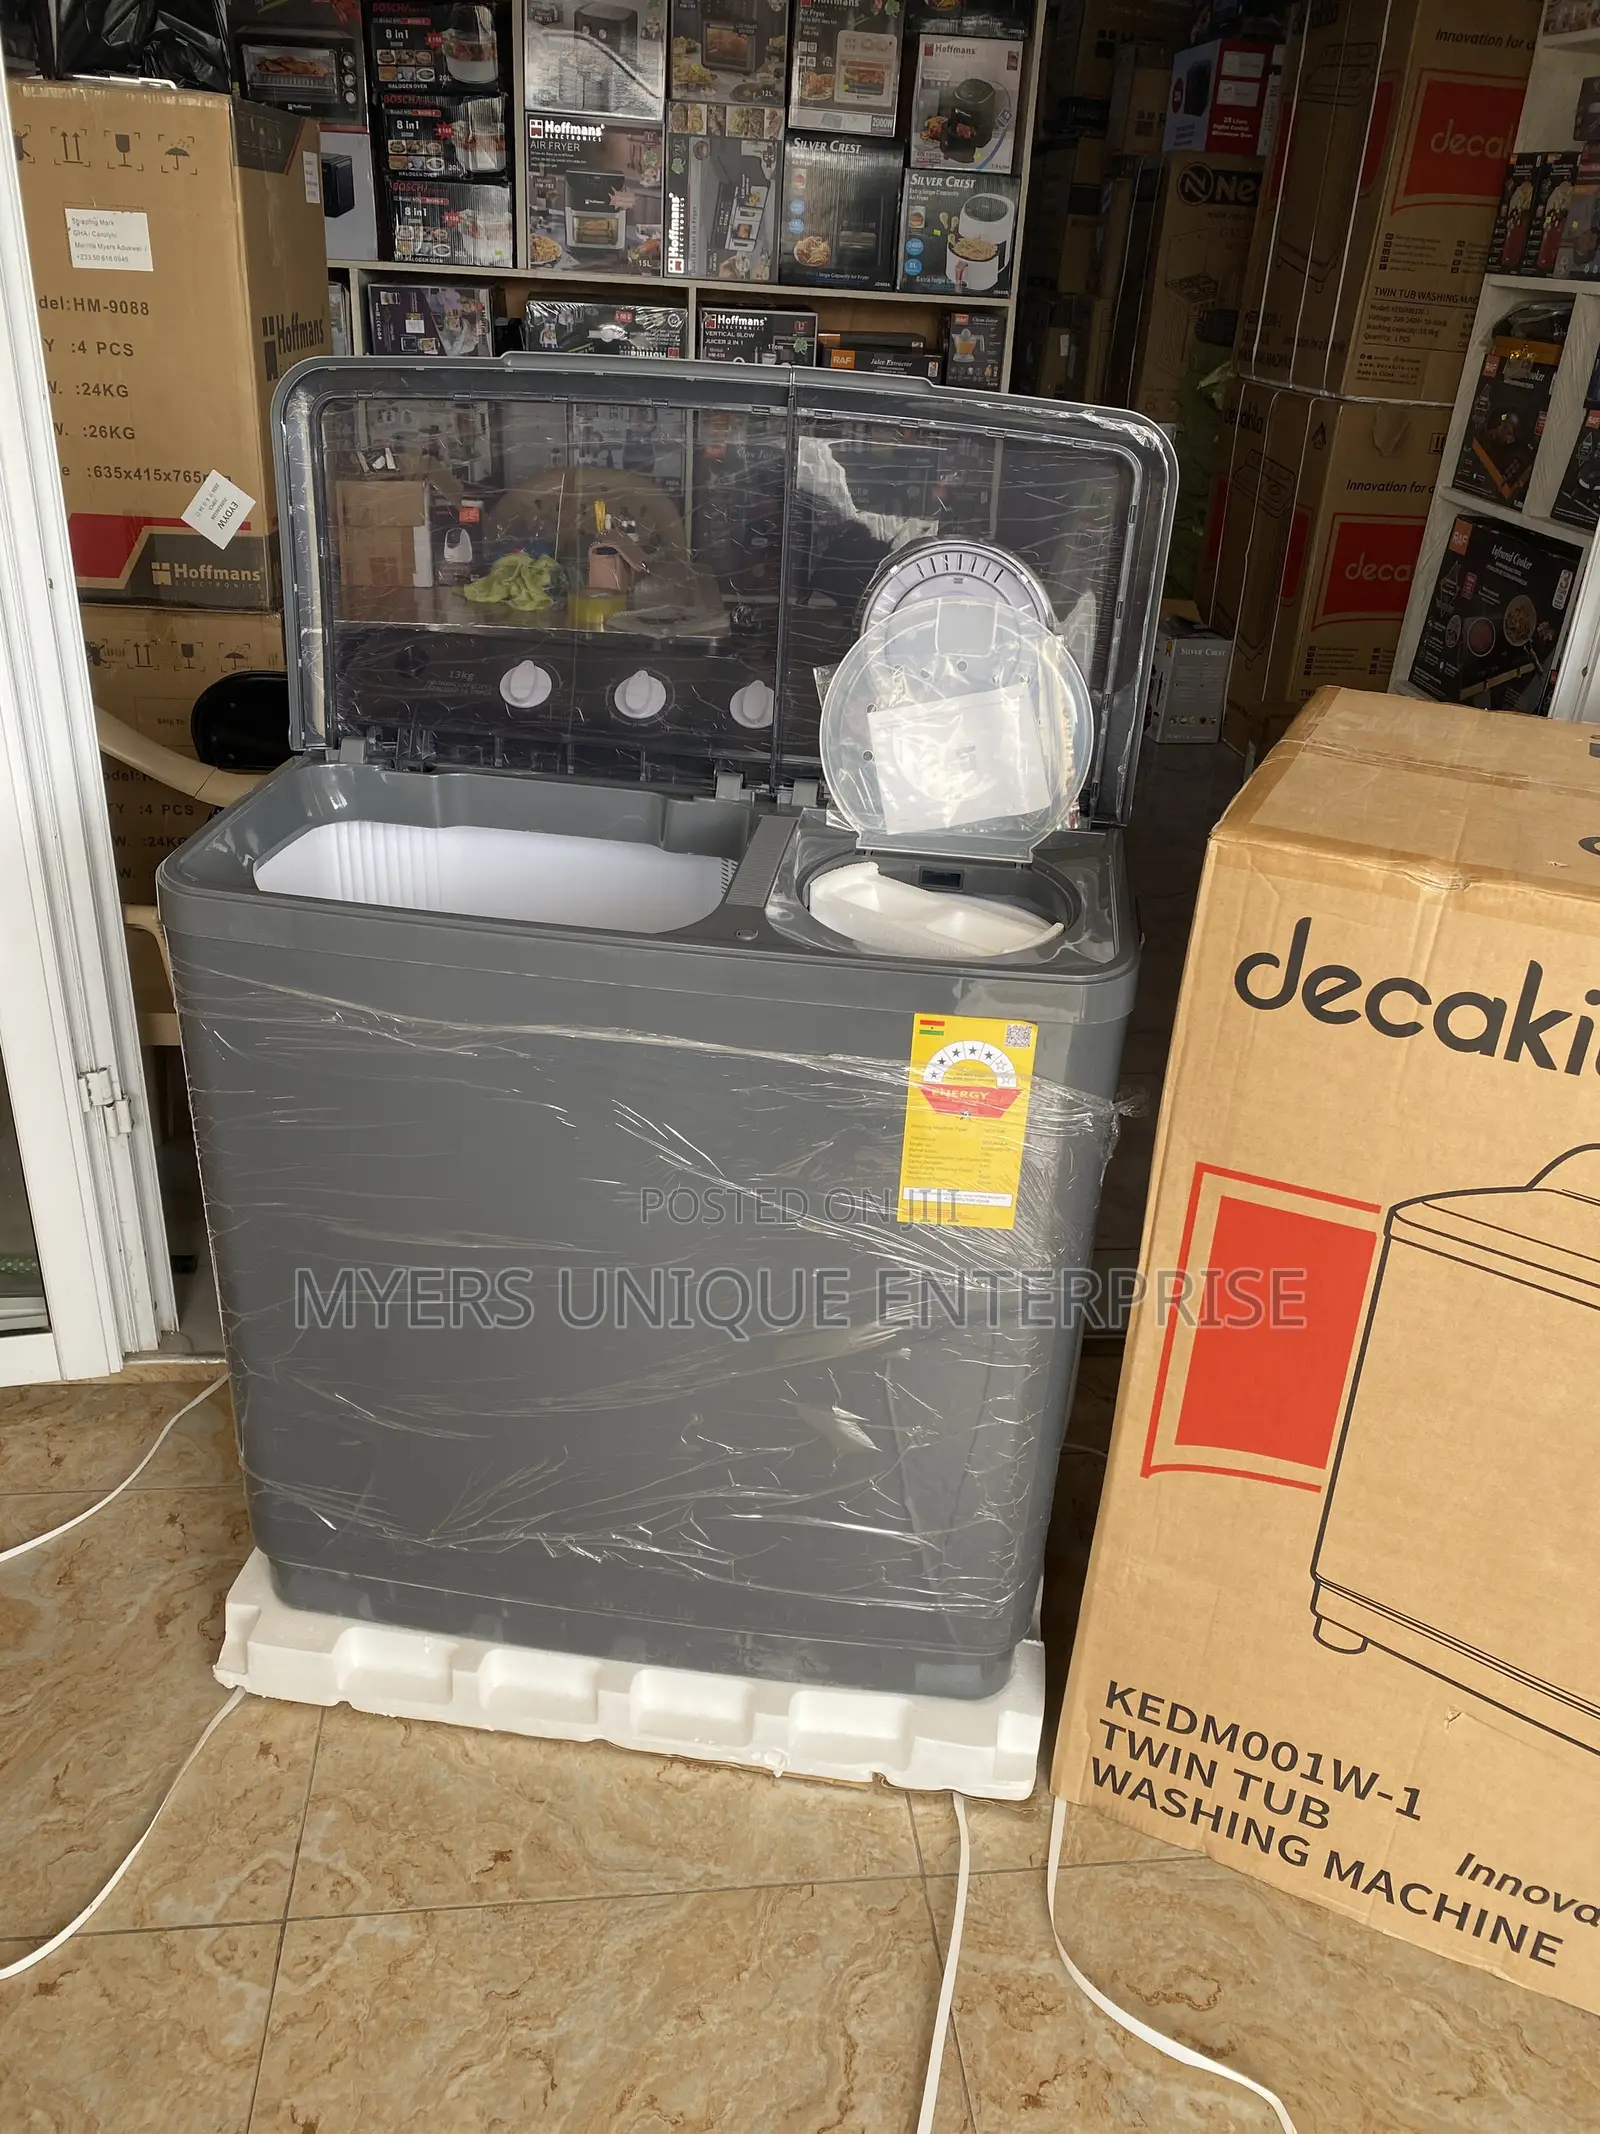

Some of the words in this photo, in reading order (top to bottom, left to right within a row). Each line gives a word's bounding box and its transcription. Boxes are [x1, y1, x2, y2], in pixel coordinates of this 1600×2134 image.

[386, 29, 392, 38] 8
[1436, 28, 1502, 48] Innovation
[1506, 34, 1524, 49] for
[936, 44, 976, 55] Hoffmans
[396, 120, 403, 129] 8
[545, 120, 601, 136] Hoffmans
[530, 141, 546, 149] AIR
[549, 141, 580, 151] FRYER
[793, 137, 827, 150] SILVER
[830, 140, 862, 154] CREST
[910, 174, 942, 186] SILVER
[946, 176, 976, 189] CREST
[404, 207, 411, 216] 8
[668, 196, 680, 257] Hoffmans
[1374, 286, 1396, 297] TWIN
[1399, 289, 1416, 300] TUB
[1418, 291, 1458, 303] WASHING
[1459, 295, 1478, 305] MAC
[38, 294, 150, 316] del:HM-9088
[718, 314, 765, 326] Hoffmans
[276, 310, 324, 355] Hoffmans
[96, 341, 134, 357] PCS
[833, 356, 852, 364] RAF
[1526, 369, 1545, 382] ooker
[75, 382, 128, 398] :24KG
[83, 424, 135, 440] :26KG
[1346, 480, 1406, 494] Innovation
[1409, 482, 1426, 494] for
[219, 501, 238, 530] EYDYW
[1452, 531, 1468, 546] RAF
[1345, 551, 1412, 582] deca
[1512, 553, 1533, 570] Cooker
[174, 563, 261, 581] Hoffmans
[175, 581, 261, 590] ELECTRONICS
[449, 670, 475, 682] 13kg
[157, 718, 174, 726] Ship
[162, 804, 194, 816] PCS
[119, 868, 136, 879] W.
[1234, 917, 1600, 1076] decaki
[931, 1088, 990, 1100] ENERGY
[1105, 1680, 1423, 1822] KEDM001W-1
[1098, 1718, 1218, 1789] TWIN
[1233, 1767, 1330, 1830] TUB
[1092, 1756, 1312, 1868] WASHING
[1324, 1850, 1564, 1968] MACHINE
[1456, 1852, 1600, 1928] Innova
